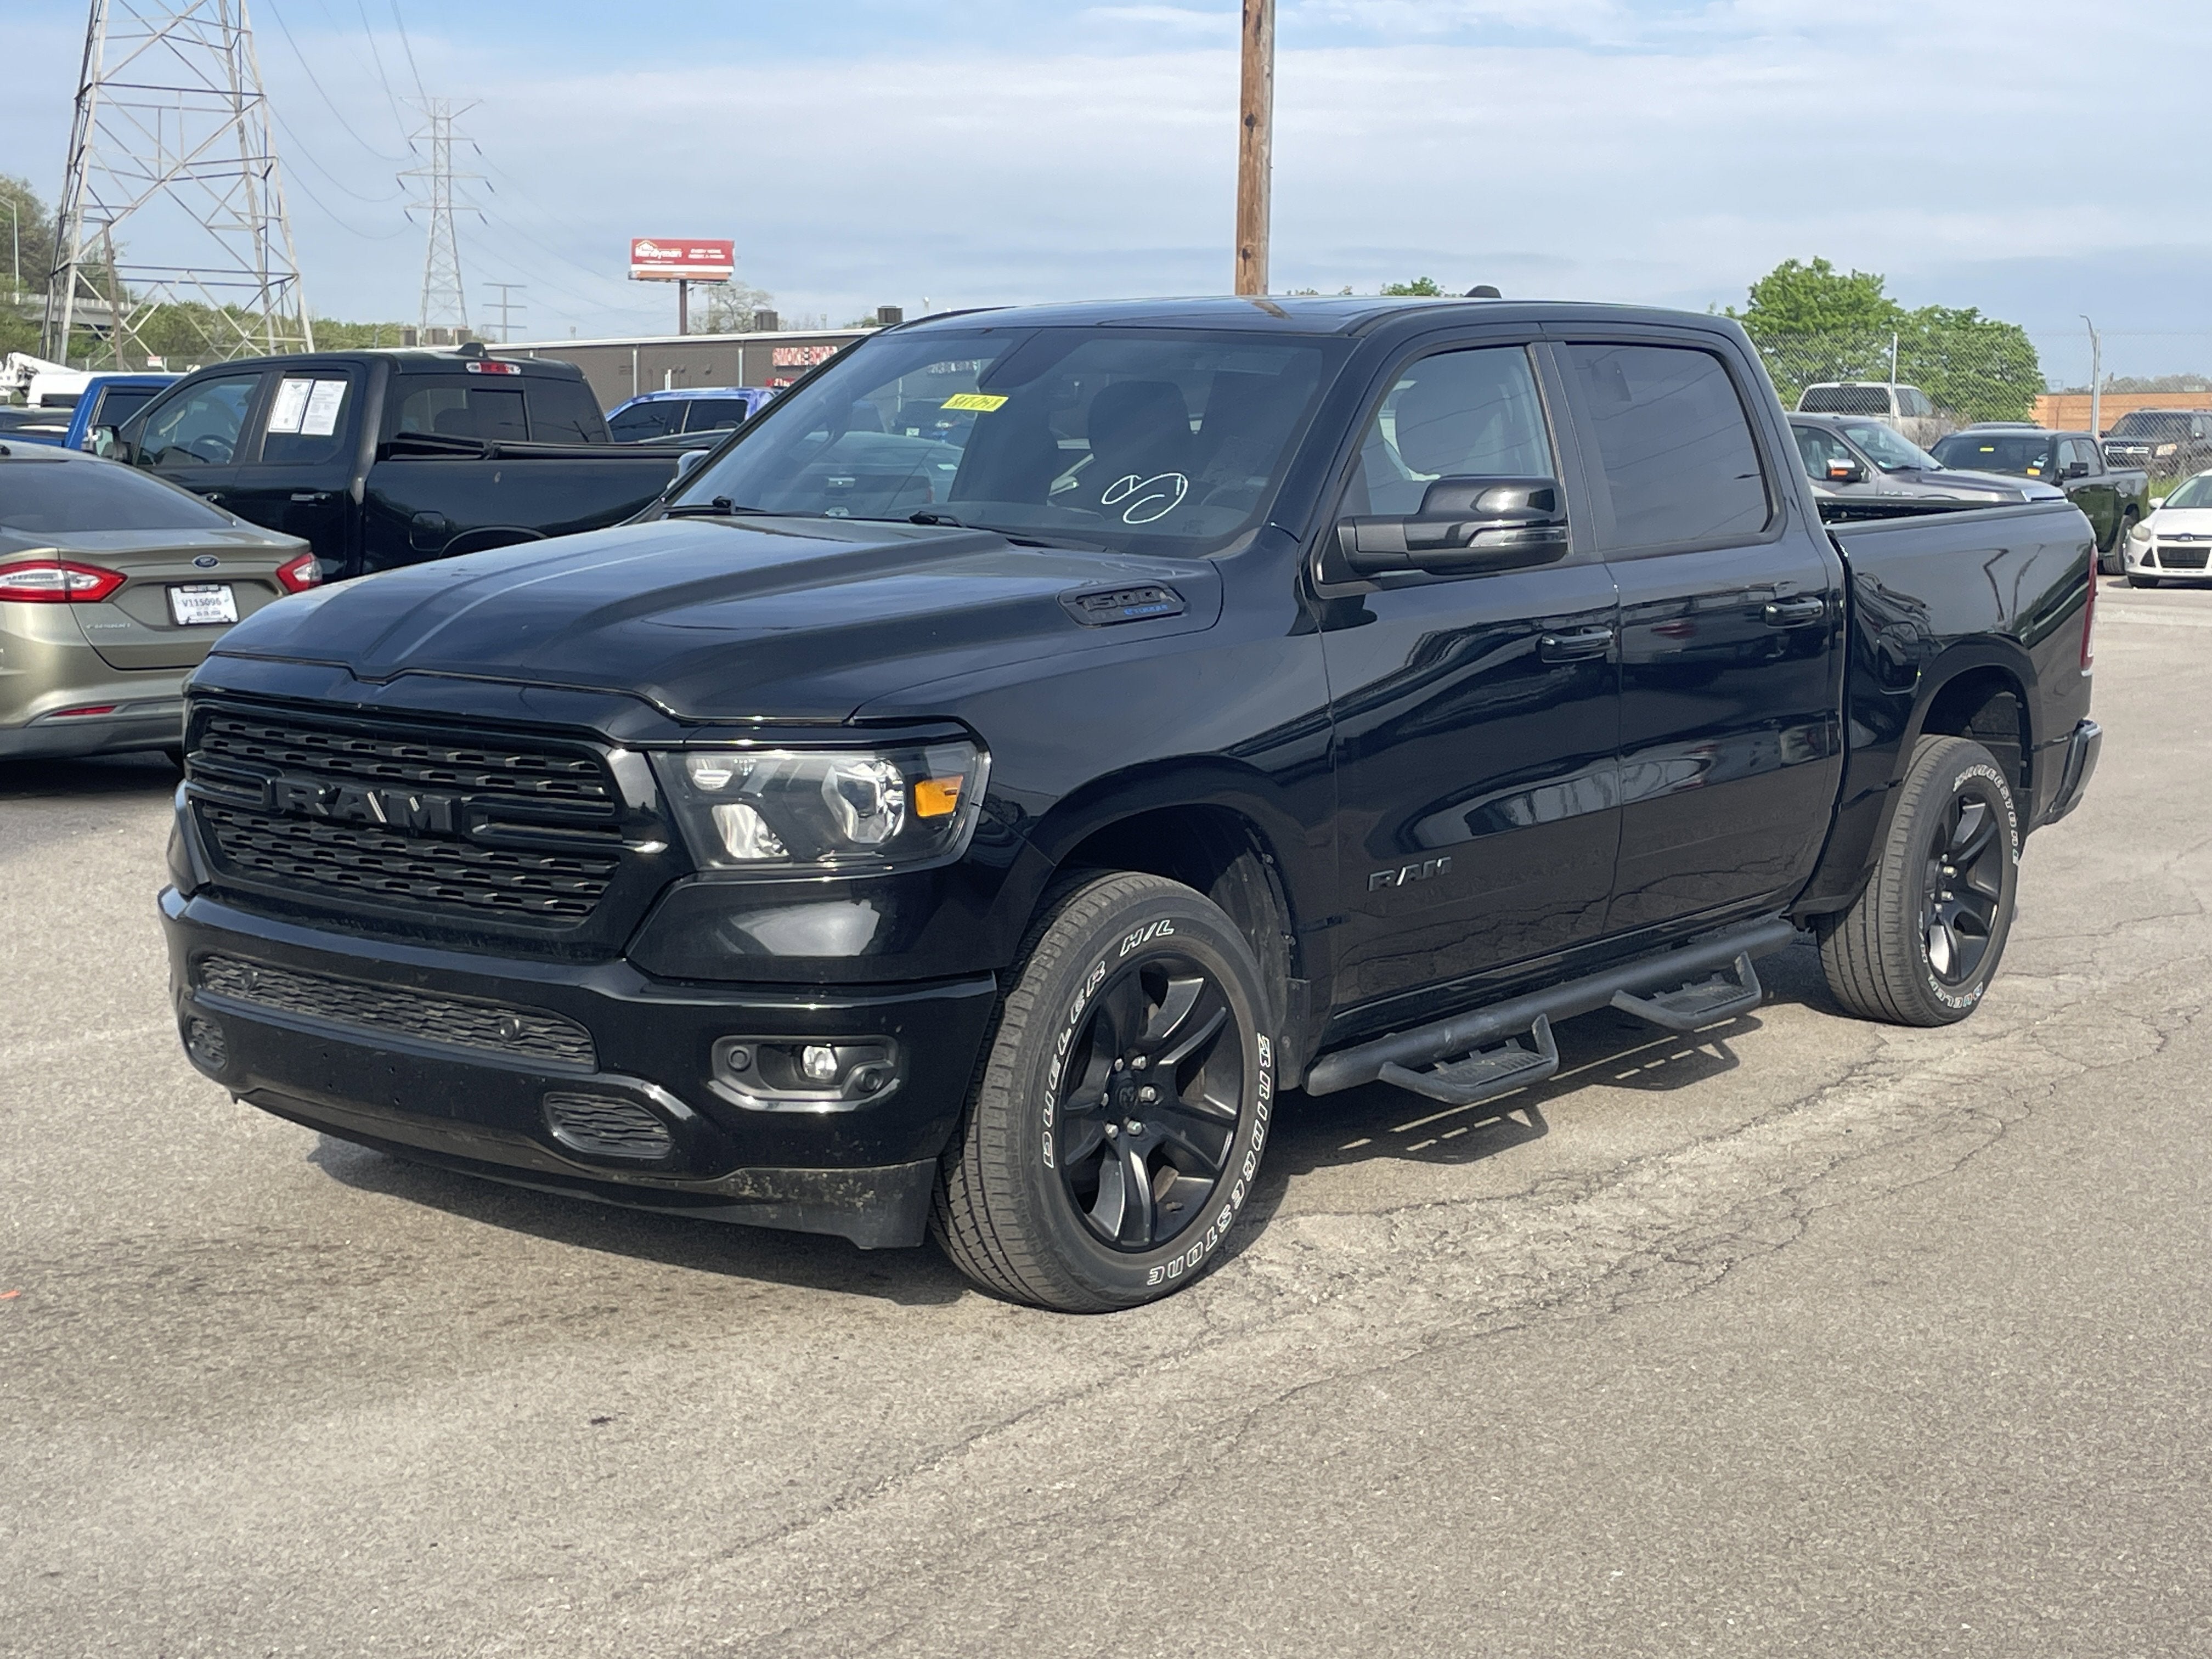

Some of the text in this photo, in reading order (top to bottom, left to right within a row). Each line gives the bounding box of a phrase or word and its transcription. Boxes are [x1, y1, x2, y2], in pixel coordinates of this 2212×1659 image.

[276, 778, 454, 832] RAM
[1368, 857, 1452, 891] RAM
[1042, 919, 1175, 1169] DUELER H/L
[1147, 1032, 1271, 1285] BRIDGESTONE
